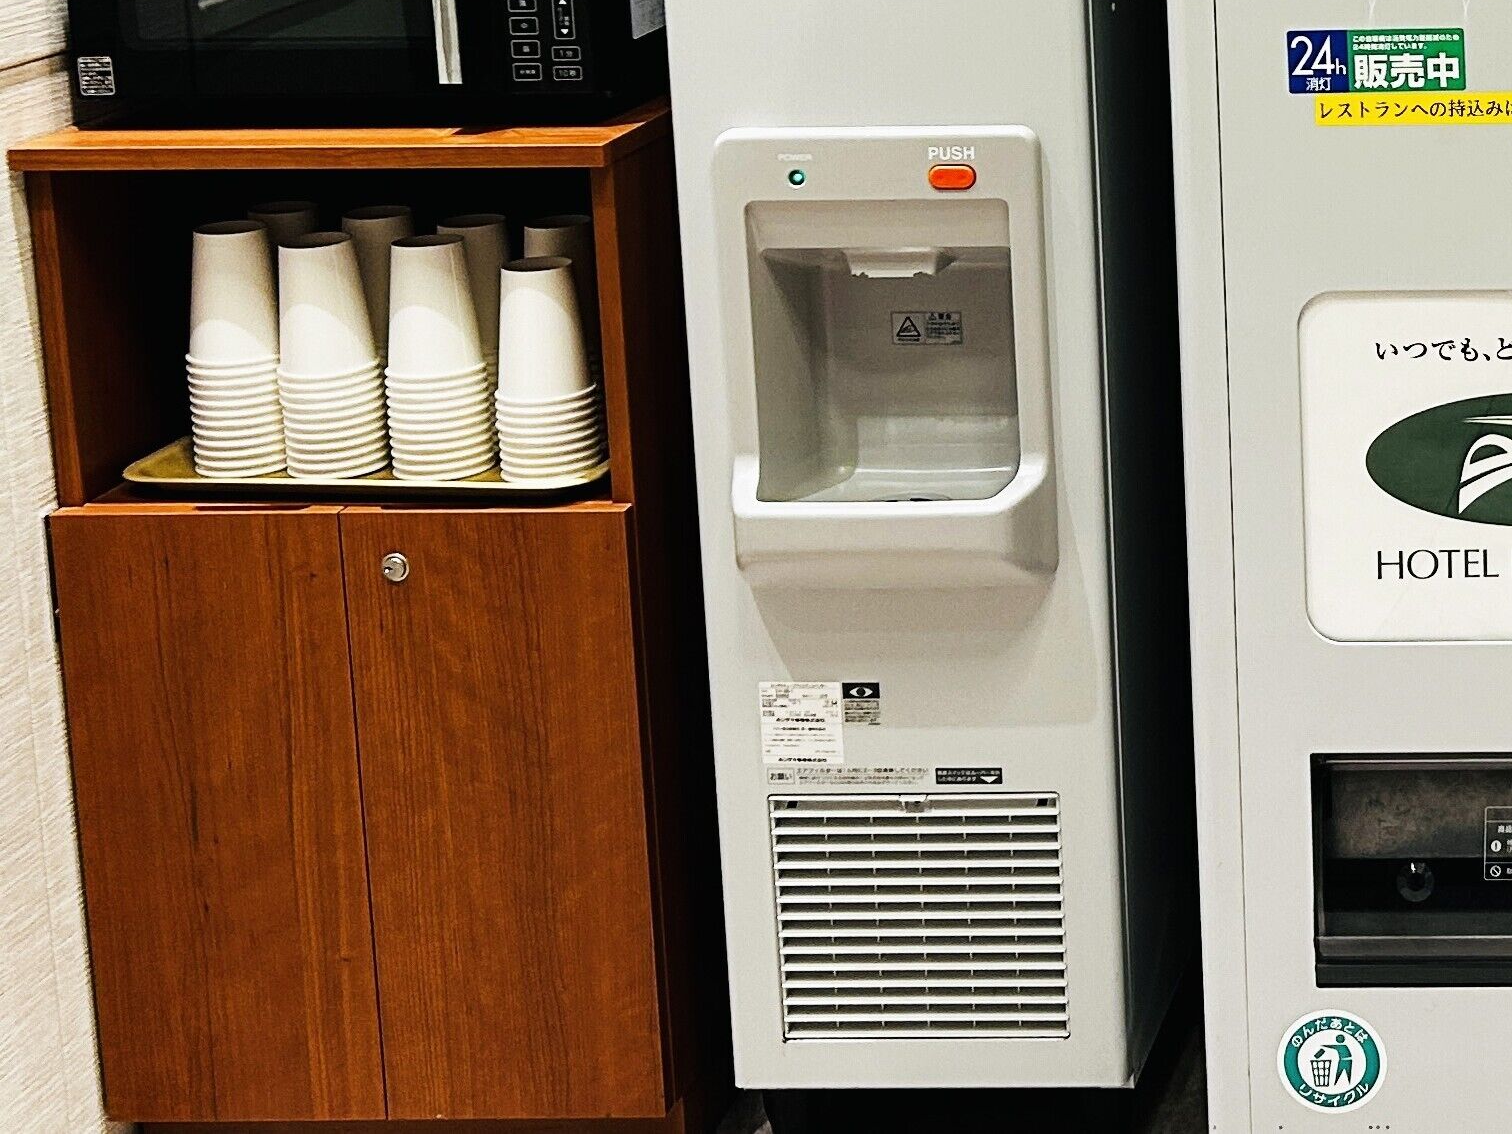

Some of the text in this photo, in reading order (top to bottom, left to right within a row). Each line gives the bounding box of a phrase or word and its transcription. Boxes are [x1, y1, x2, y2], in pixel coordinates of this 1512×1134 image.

[1290, 34, 1347, 76] 24h
[1353, 52, 1461, 89] 販売中
[1305, 77, 1331, 91] 消灯
[777, 153, 812, 162] POWER
[928, 146, 975, 161] PUSH
[1376, 549, 1500, 581] HOTEL
[1291, 1017, 1369, 1046] のんだあとは
[1298, 1083, 1370, 1107] リサイクル
